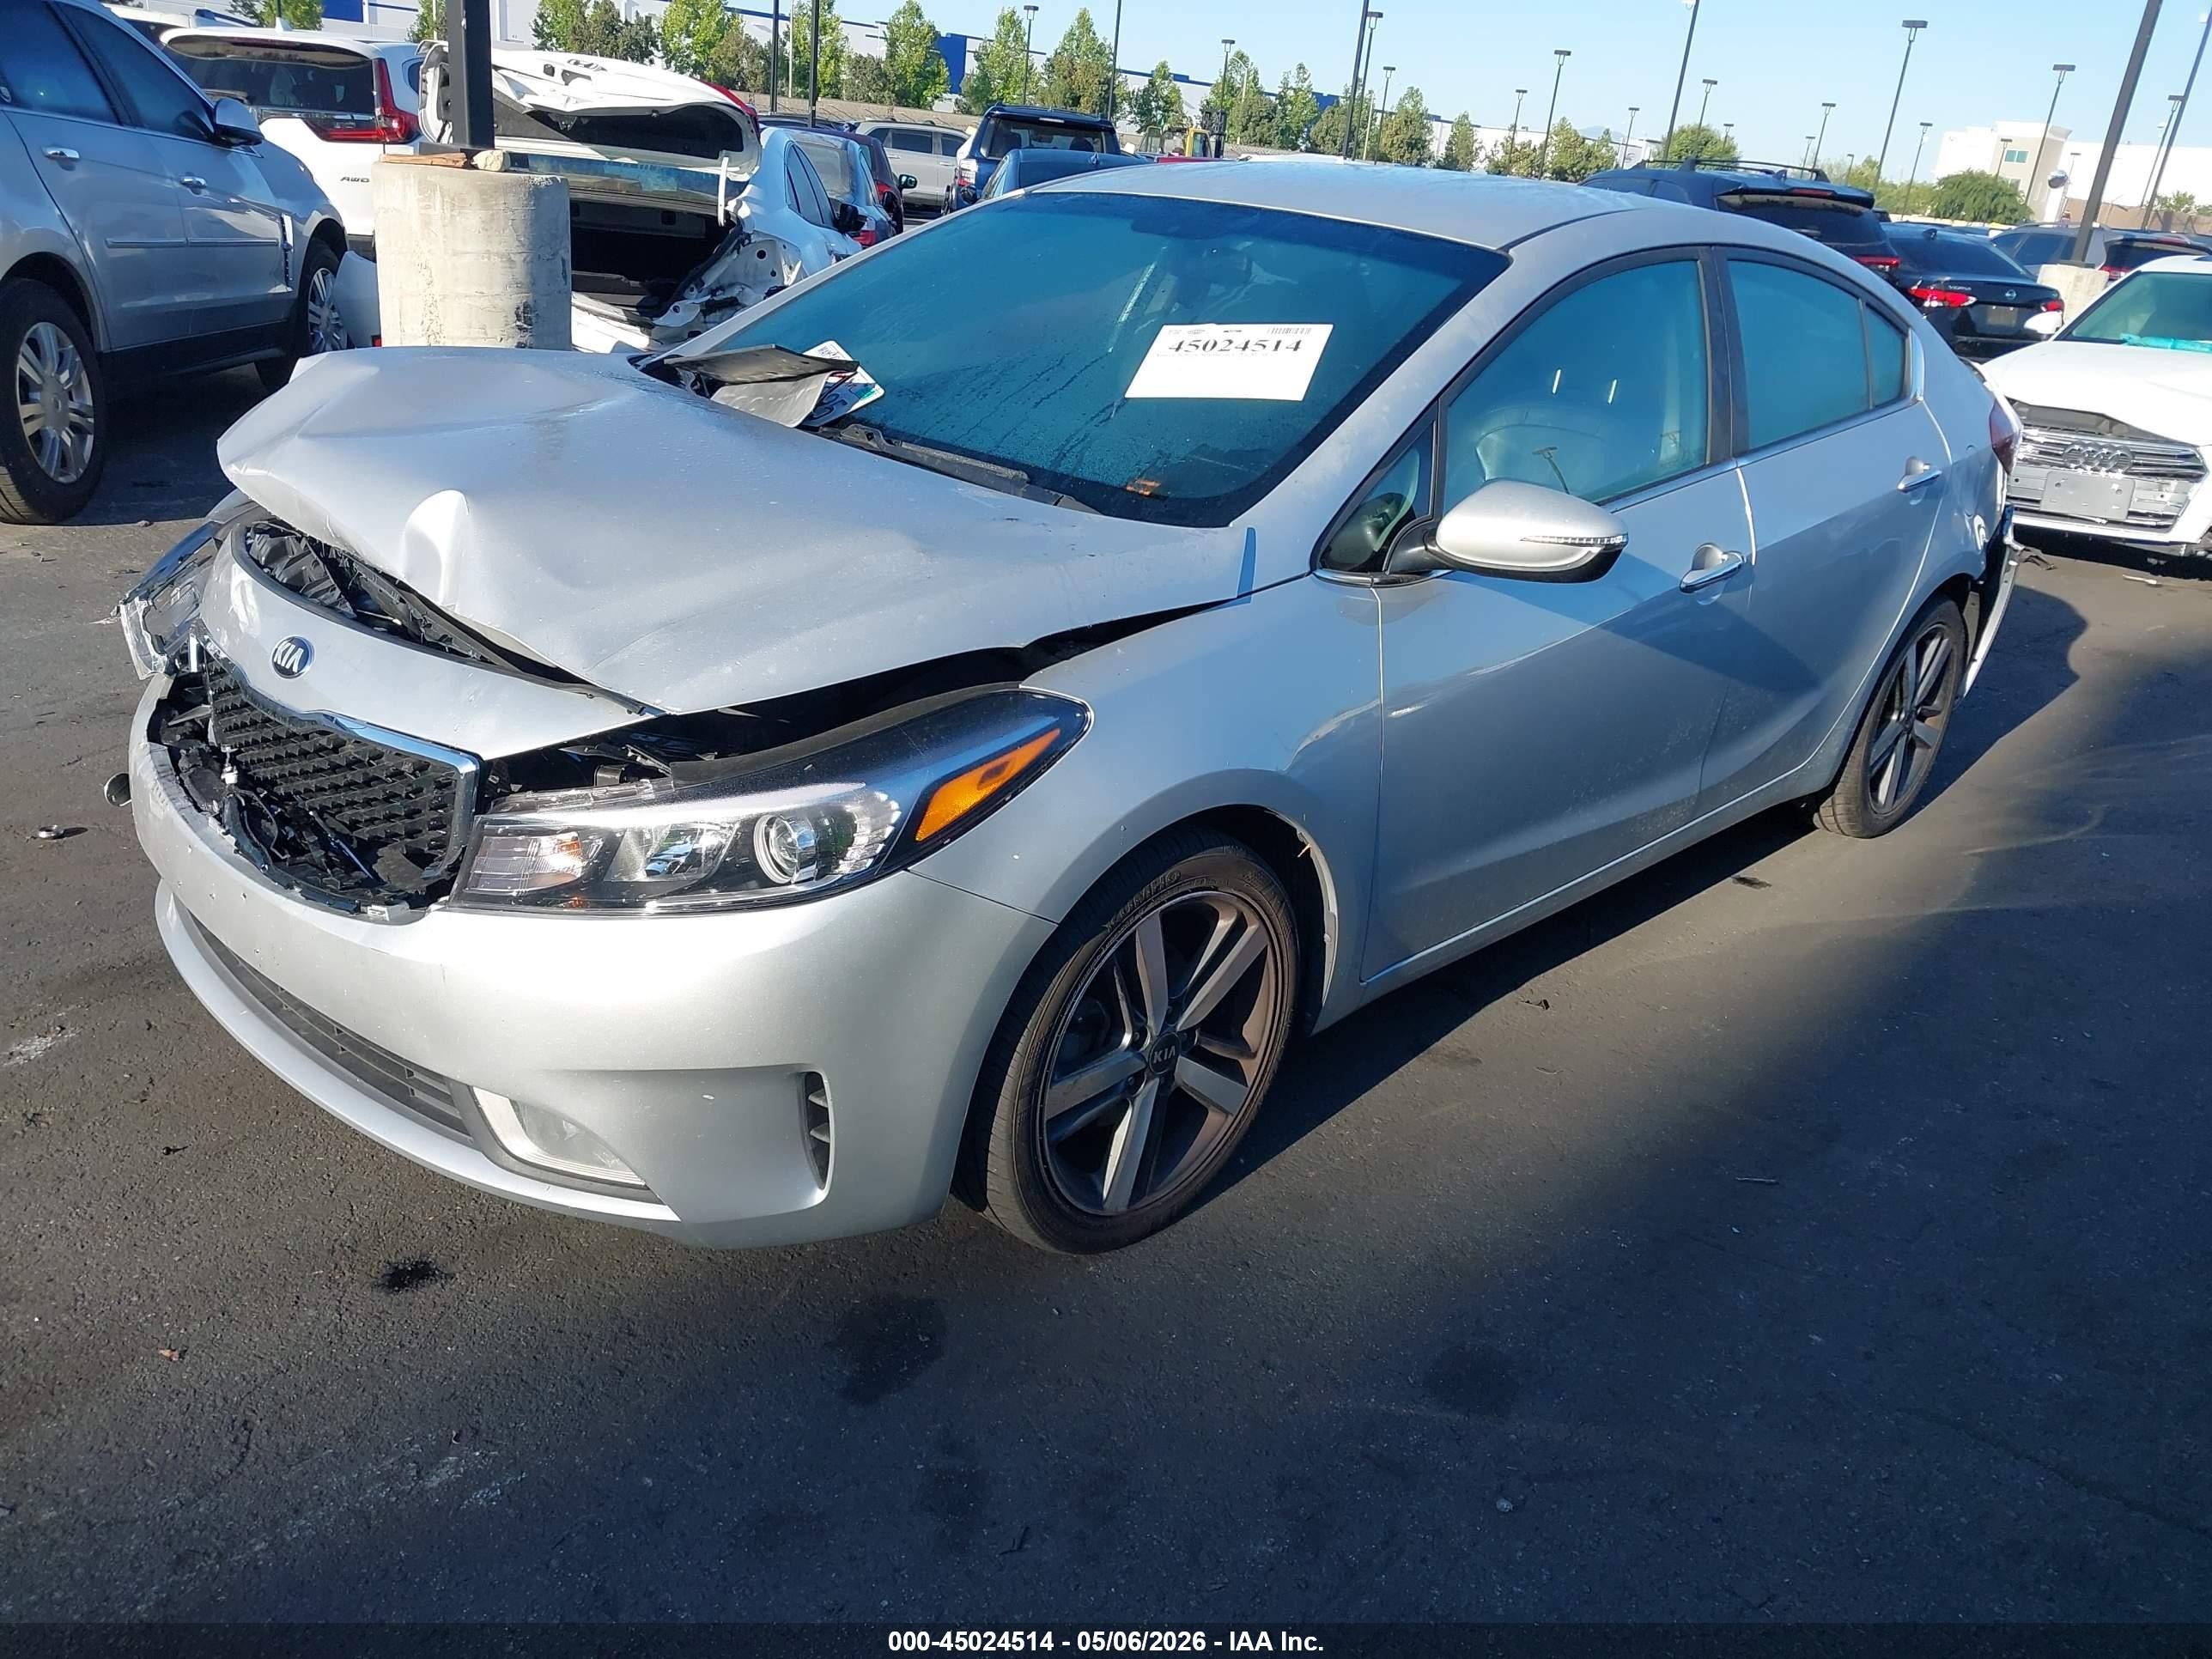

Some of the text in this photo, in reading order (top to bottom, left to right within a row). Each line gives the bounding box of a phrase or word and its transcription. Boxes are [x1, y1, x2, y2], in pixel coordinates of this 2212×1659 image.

[1168, 338, 1303, 352] 45024514
[273, 640, 303, 672] KIA
[1152, 1045, 1176, 1064] KIA
